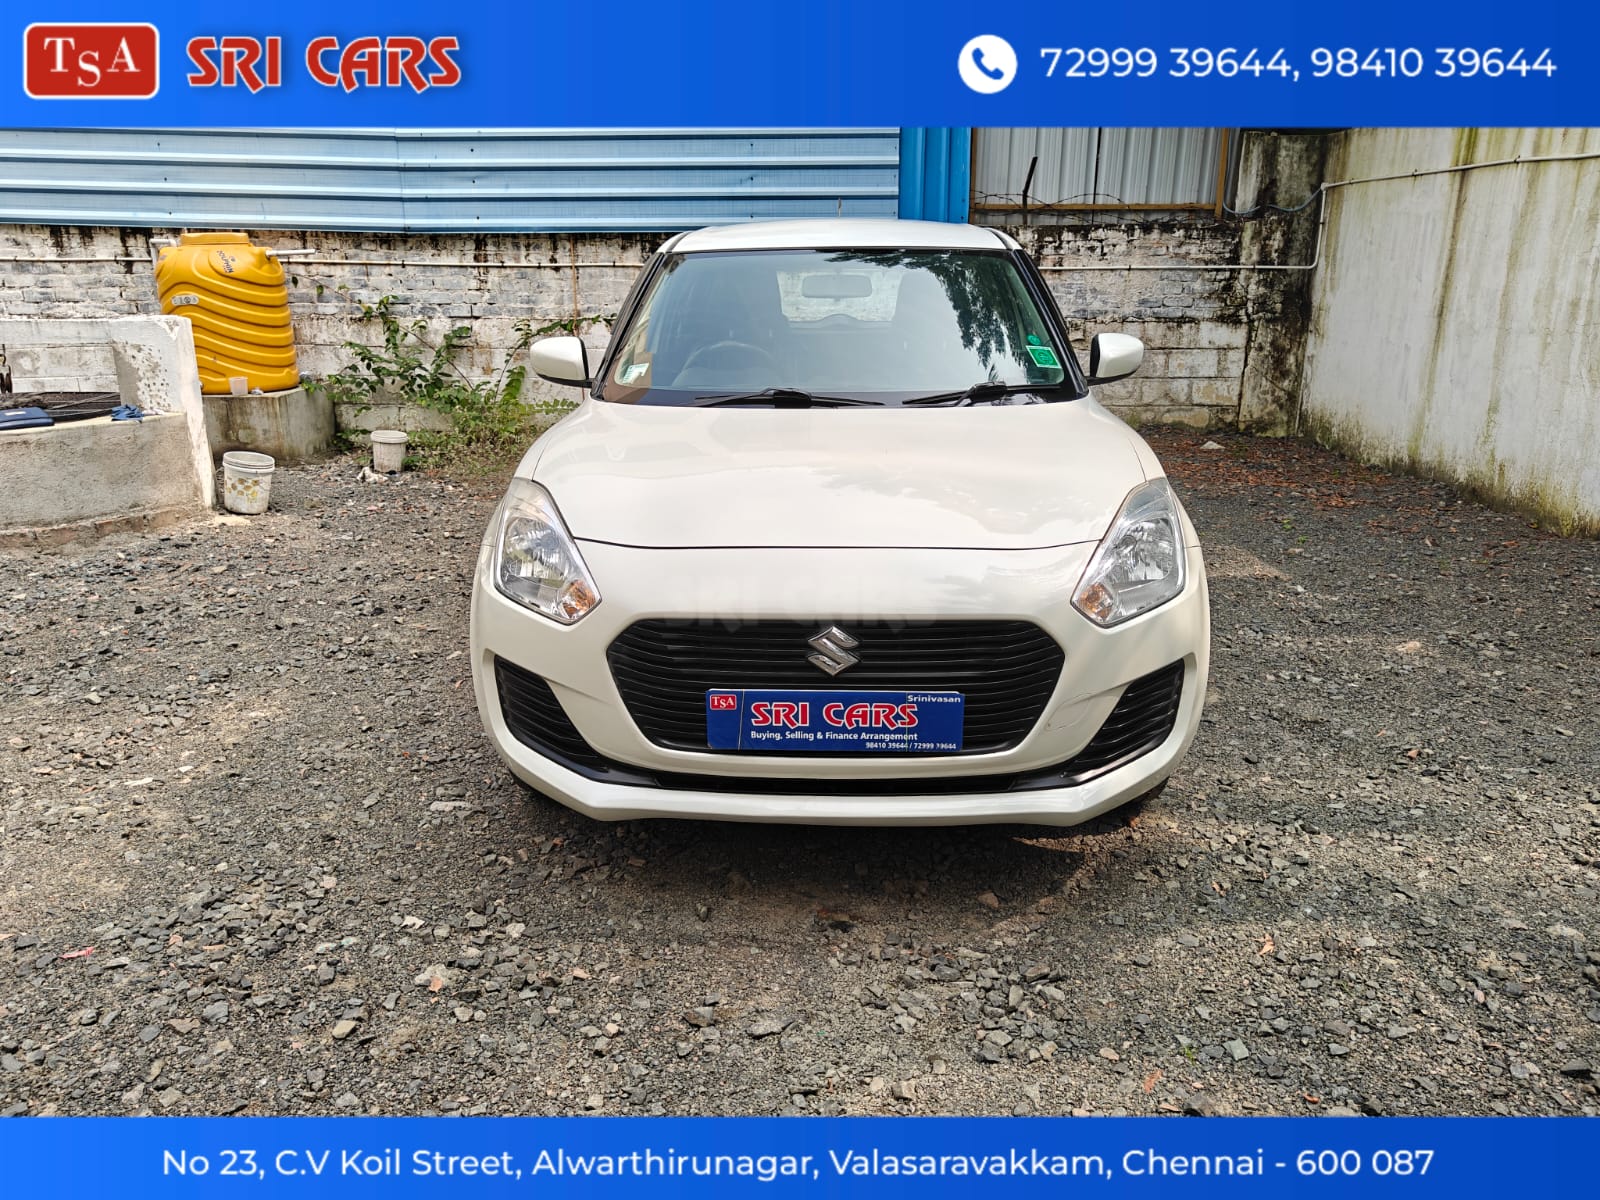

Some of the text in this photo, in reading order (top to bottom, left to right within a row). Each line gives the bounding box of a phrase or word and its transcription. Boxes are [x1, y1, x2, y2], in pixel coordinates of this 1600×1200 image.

[712, 696, 734, 708] TSA
[907, 694, 961, 703] Srinivasan
[751, 702, 919, 730] SRI CARS
[785, 731, 815, 741] Selling
[816, 731, 824, 740] &
[825, 731, 859, 741] Finance
[860, 732, 918, 742] Arrangement
